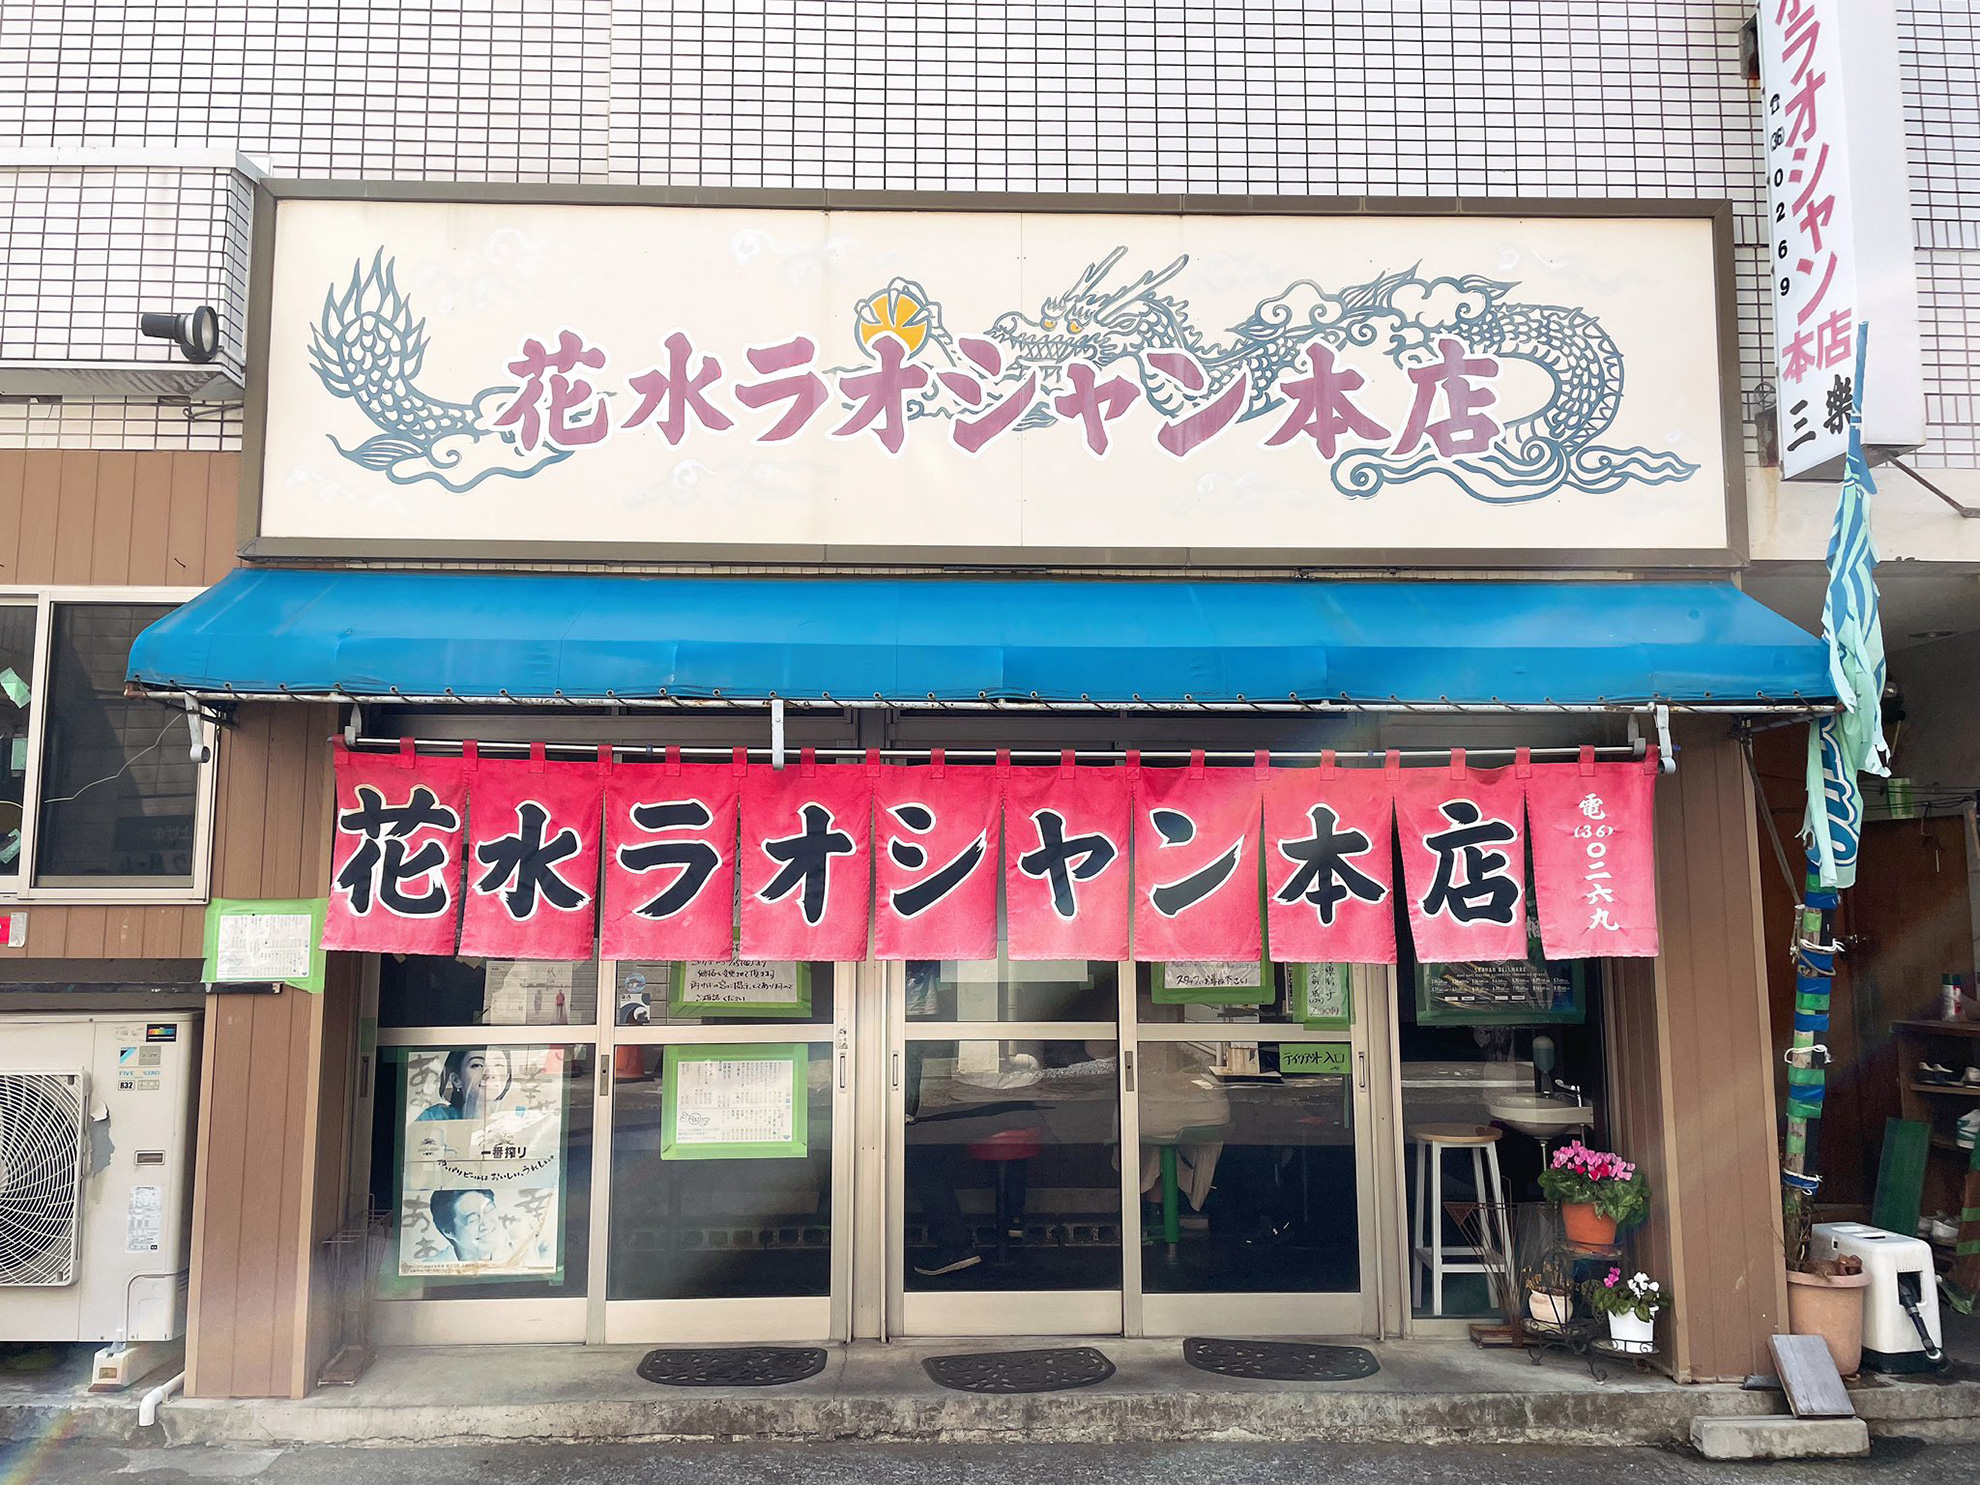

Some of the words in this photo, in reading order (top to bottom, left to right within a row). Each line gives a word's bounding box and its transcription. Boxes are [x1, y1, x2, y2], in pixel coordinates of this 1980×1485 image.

[493, 329, 1502, 459] 花水ラオシャン本店
[1782, 308, 1852, 384] 本店
[333, 785, 1522, 928] 花水ラオシャン本店
[481, 1146, 527, 1159] 一番搾り
